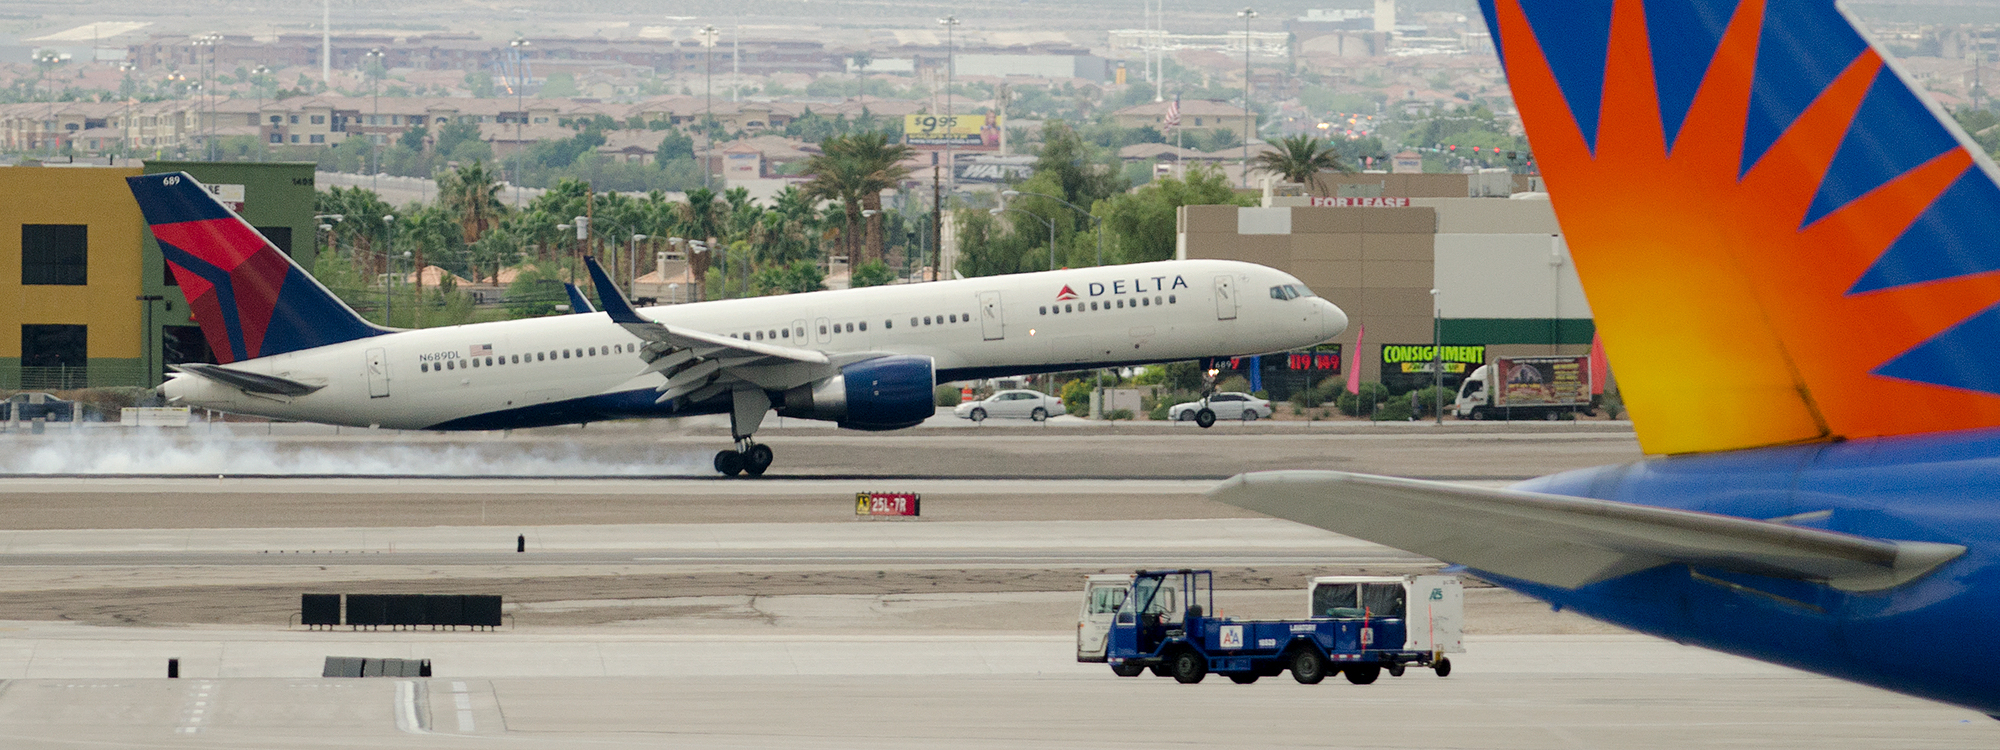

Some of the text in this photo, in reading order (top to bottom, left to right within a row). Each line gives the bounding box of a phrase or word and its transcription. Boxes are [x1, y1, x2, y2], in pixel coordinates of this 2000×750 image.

[163, 176, 181, 186] 689
[1314, 197, 1407, 207] FOR LEASE
[1089, 275, 1188, 297] DELTA
[419, 351, 461, 362] N689DL
[1383, 345, 1485, 364] CONSIGNMENT
